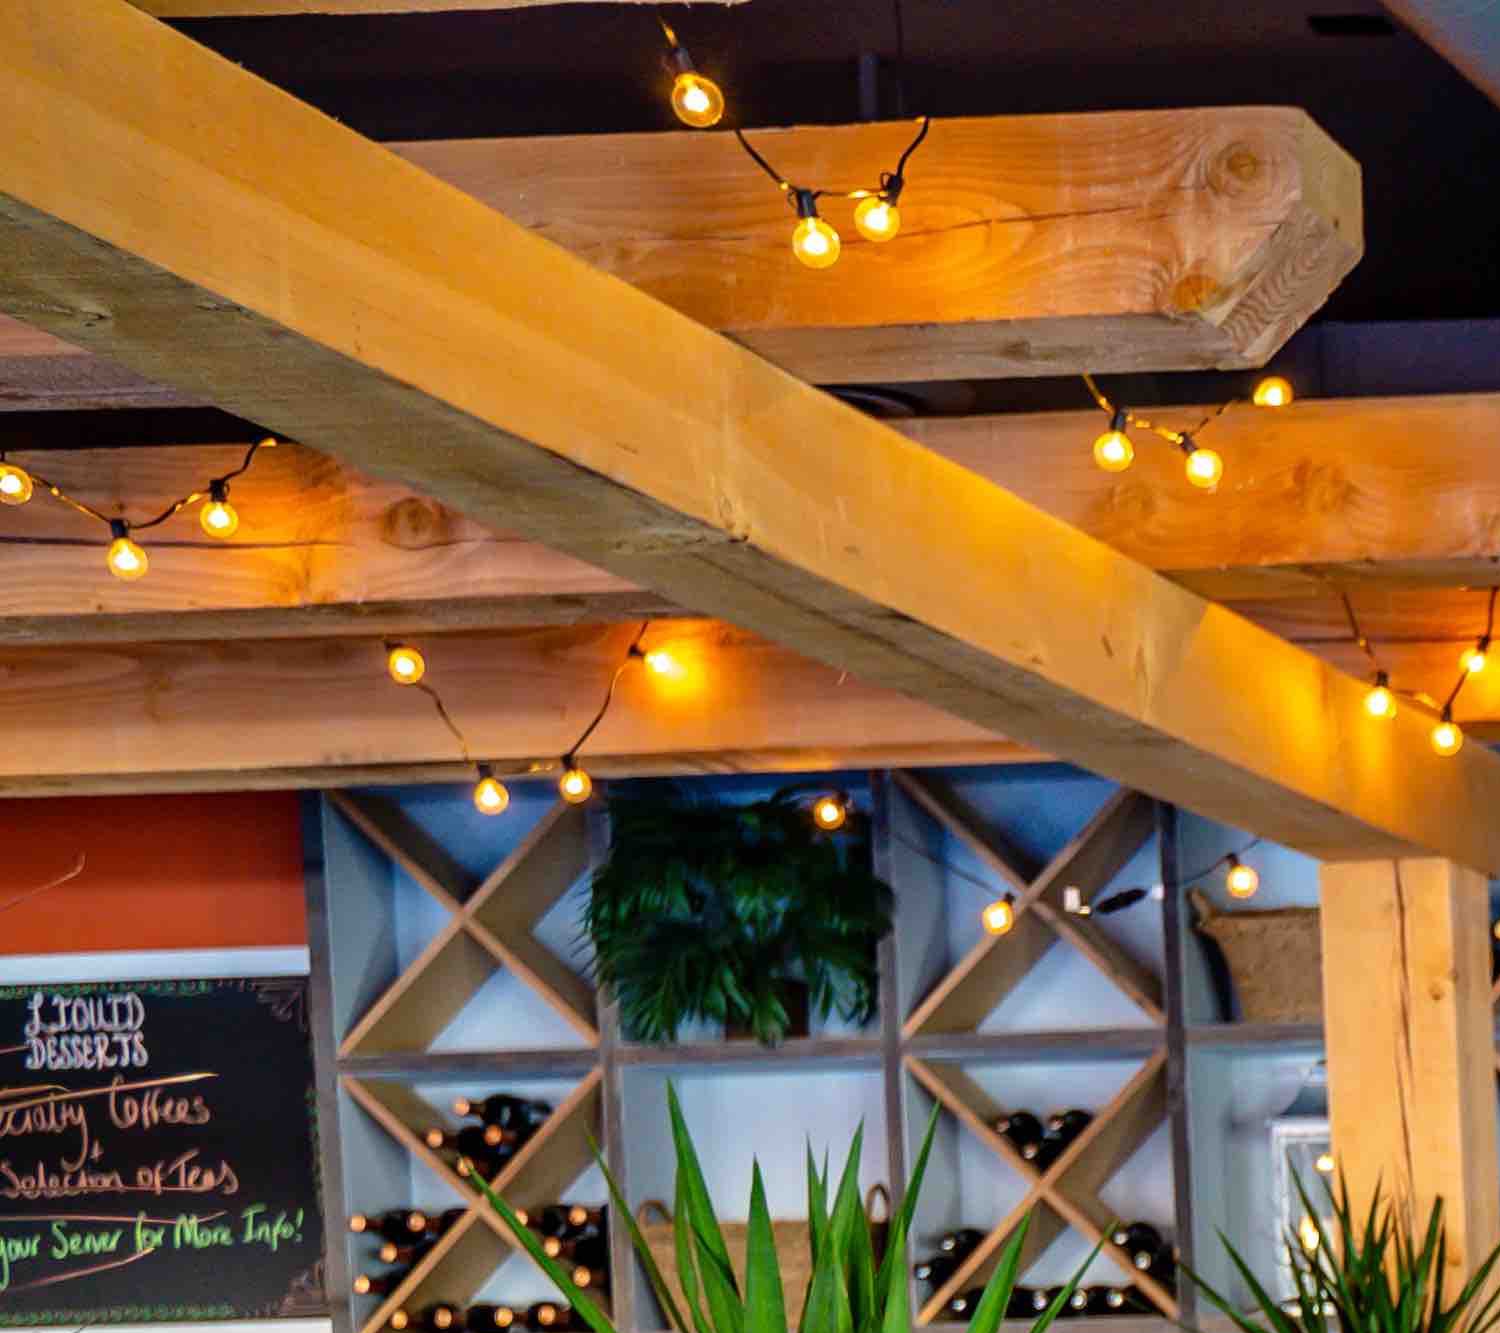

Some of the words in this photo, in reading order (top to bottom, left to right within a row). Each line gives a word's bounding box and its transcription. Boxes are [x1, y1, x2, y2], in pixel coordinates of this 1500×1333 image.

[25, 1030, 149, 1070] DESSERTS
[109, 1074, 210, 1130] Coffees
[136, 1160, 164, 1195] of
[167, 1150, 239, 1195] Teas
[51, 1220, 126, 1260] Server
[134, 1210, 166, 1254] for
[174, 1212, 234, 1249] More
[241, 1203, 304, 1252] Info!
